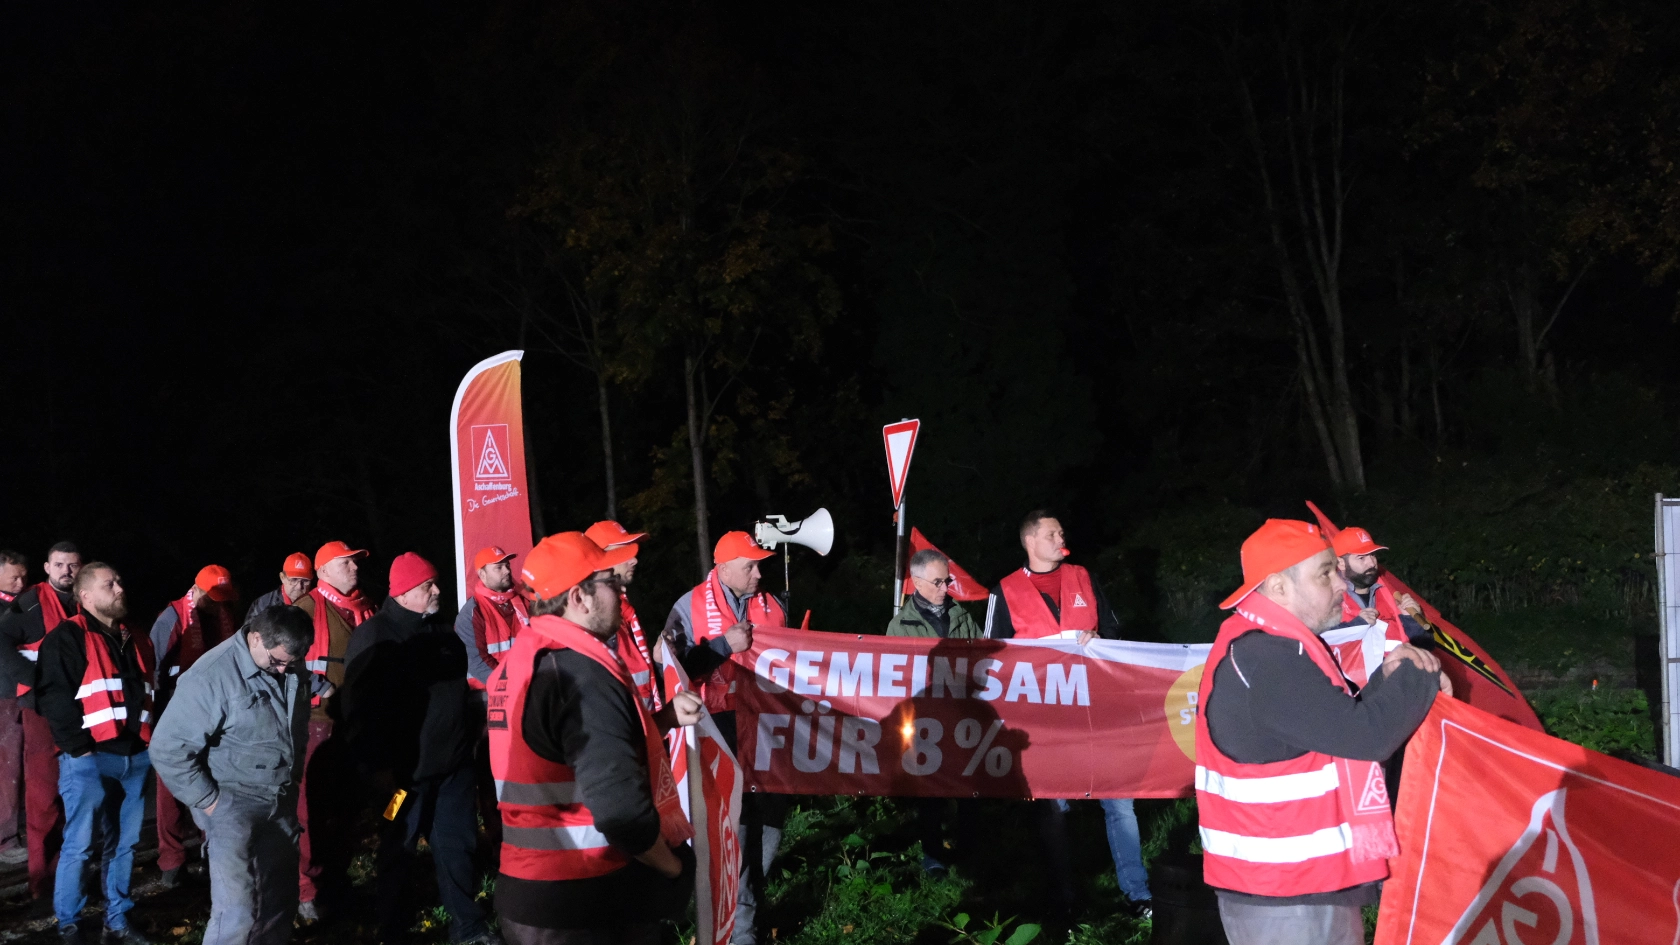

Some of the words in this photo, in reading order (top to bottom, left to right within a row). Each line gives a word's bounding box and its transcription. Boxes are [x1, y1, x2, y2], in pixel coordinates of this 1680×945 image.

[474, 482, 512, 492] Aschaffenburg
[466, 498, 480, 513] Die
[754, 648, 1091, 706] GEMEINSAM
[754, 699, 881, 775] FÜR
